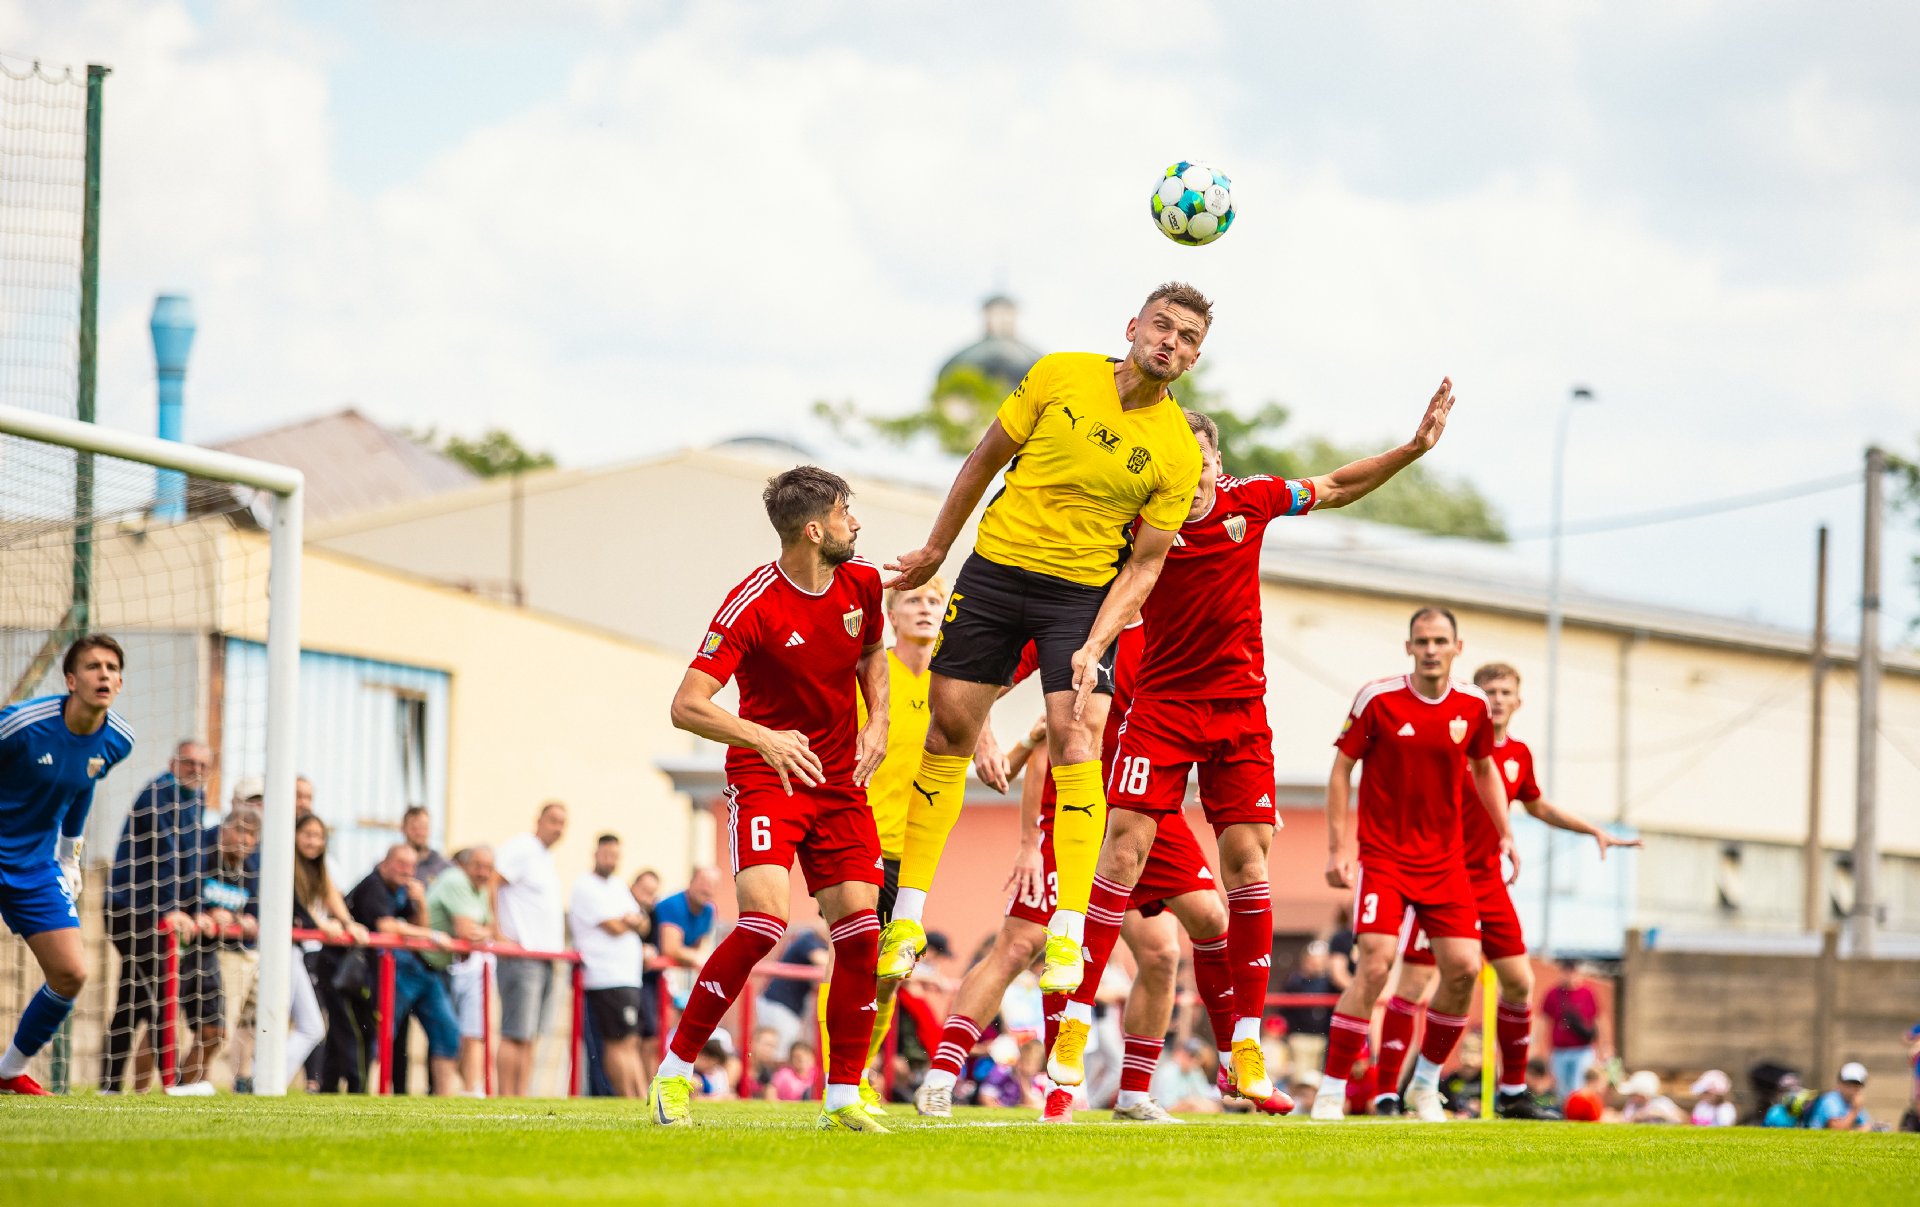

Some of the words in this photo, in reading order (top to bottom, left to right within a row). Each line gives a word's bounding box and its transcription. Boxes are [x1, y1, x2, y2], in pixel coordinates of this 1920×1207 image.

[1093, 428, 1121, 449] AZ
[945, 592, 965, 623] 5
[1118, 755, 1151, 796] 18
[750, 815, 772, 852] 6
[1361, 892, 1379, 924] 3
